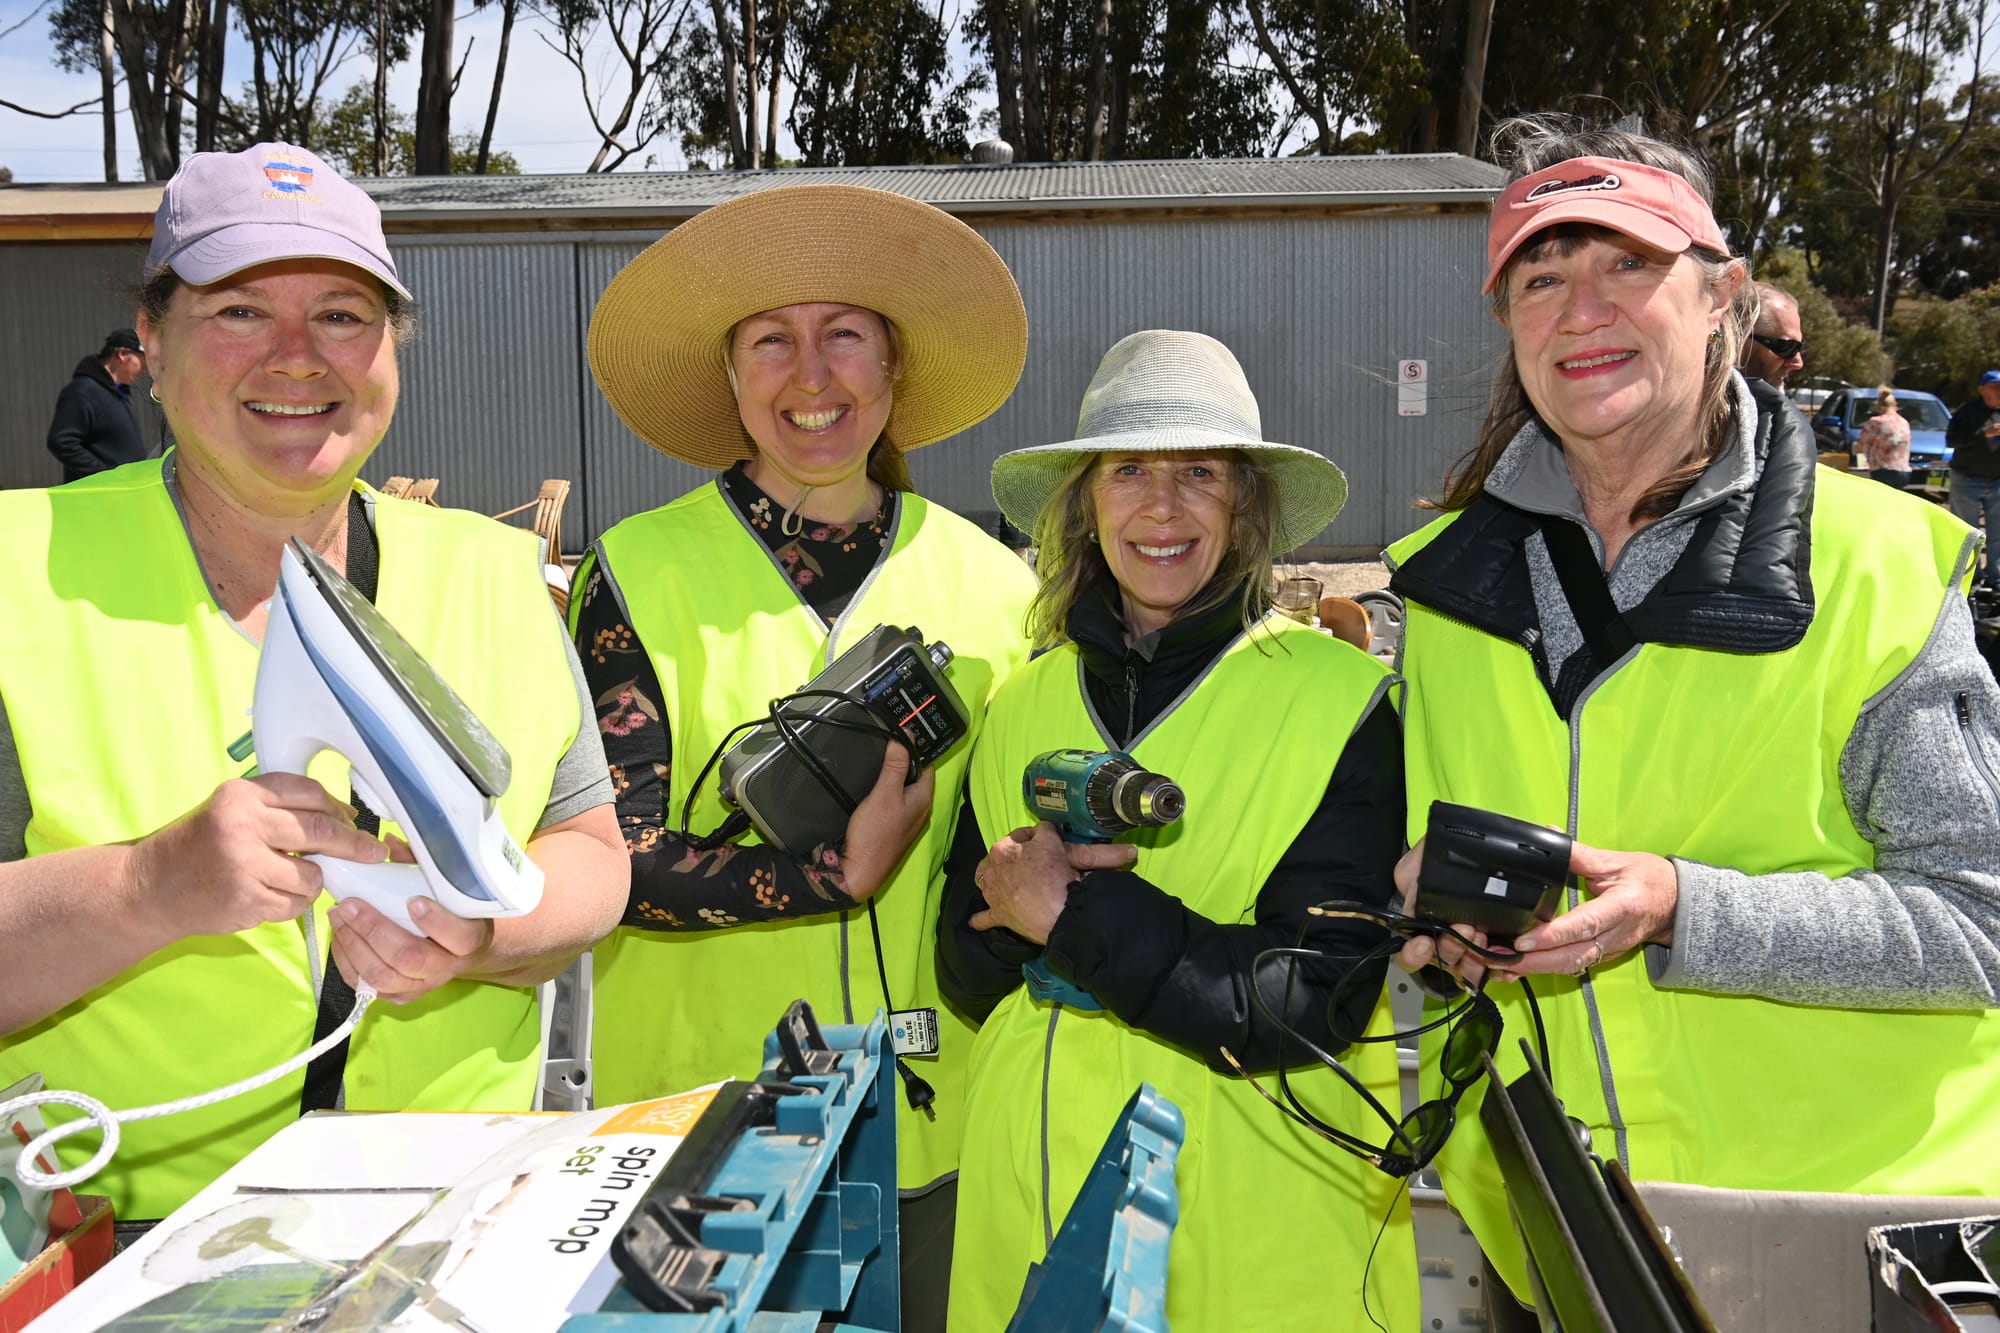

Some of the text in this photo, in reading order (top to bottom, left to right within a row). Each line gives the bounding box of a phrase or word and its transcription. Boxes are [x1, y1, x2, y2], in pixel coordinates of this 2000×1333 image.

[1408, 365, 1418, 377] S
[864, 666, 893, 690] Panasonic
[882, 670, 913, 697] FM AM
[926, 704, 938, 716] 100
[906, 1020, 915, 1045] PULSE
[559, 1145, 605, 1175] set
[600, 1146, 657, 1190] spin
[548, 1199, 620, 1253] mop
